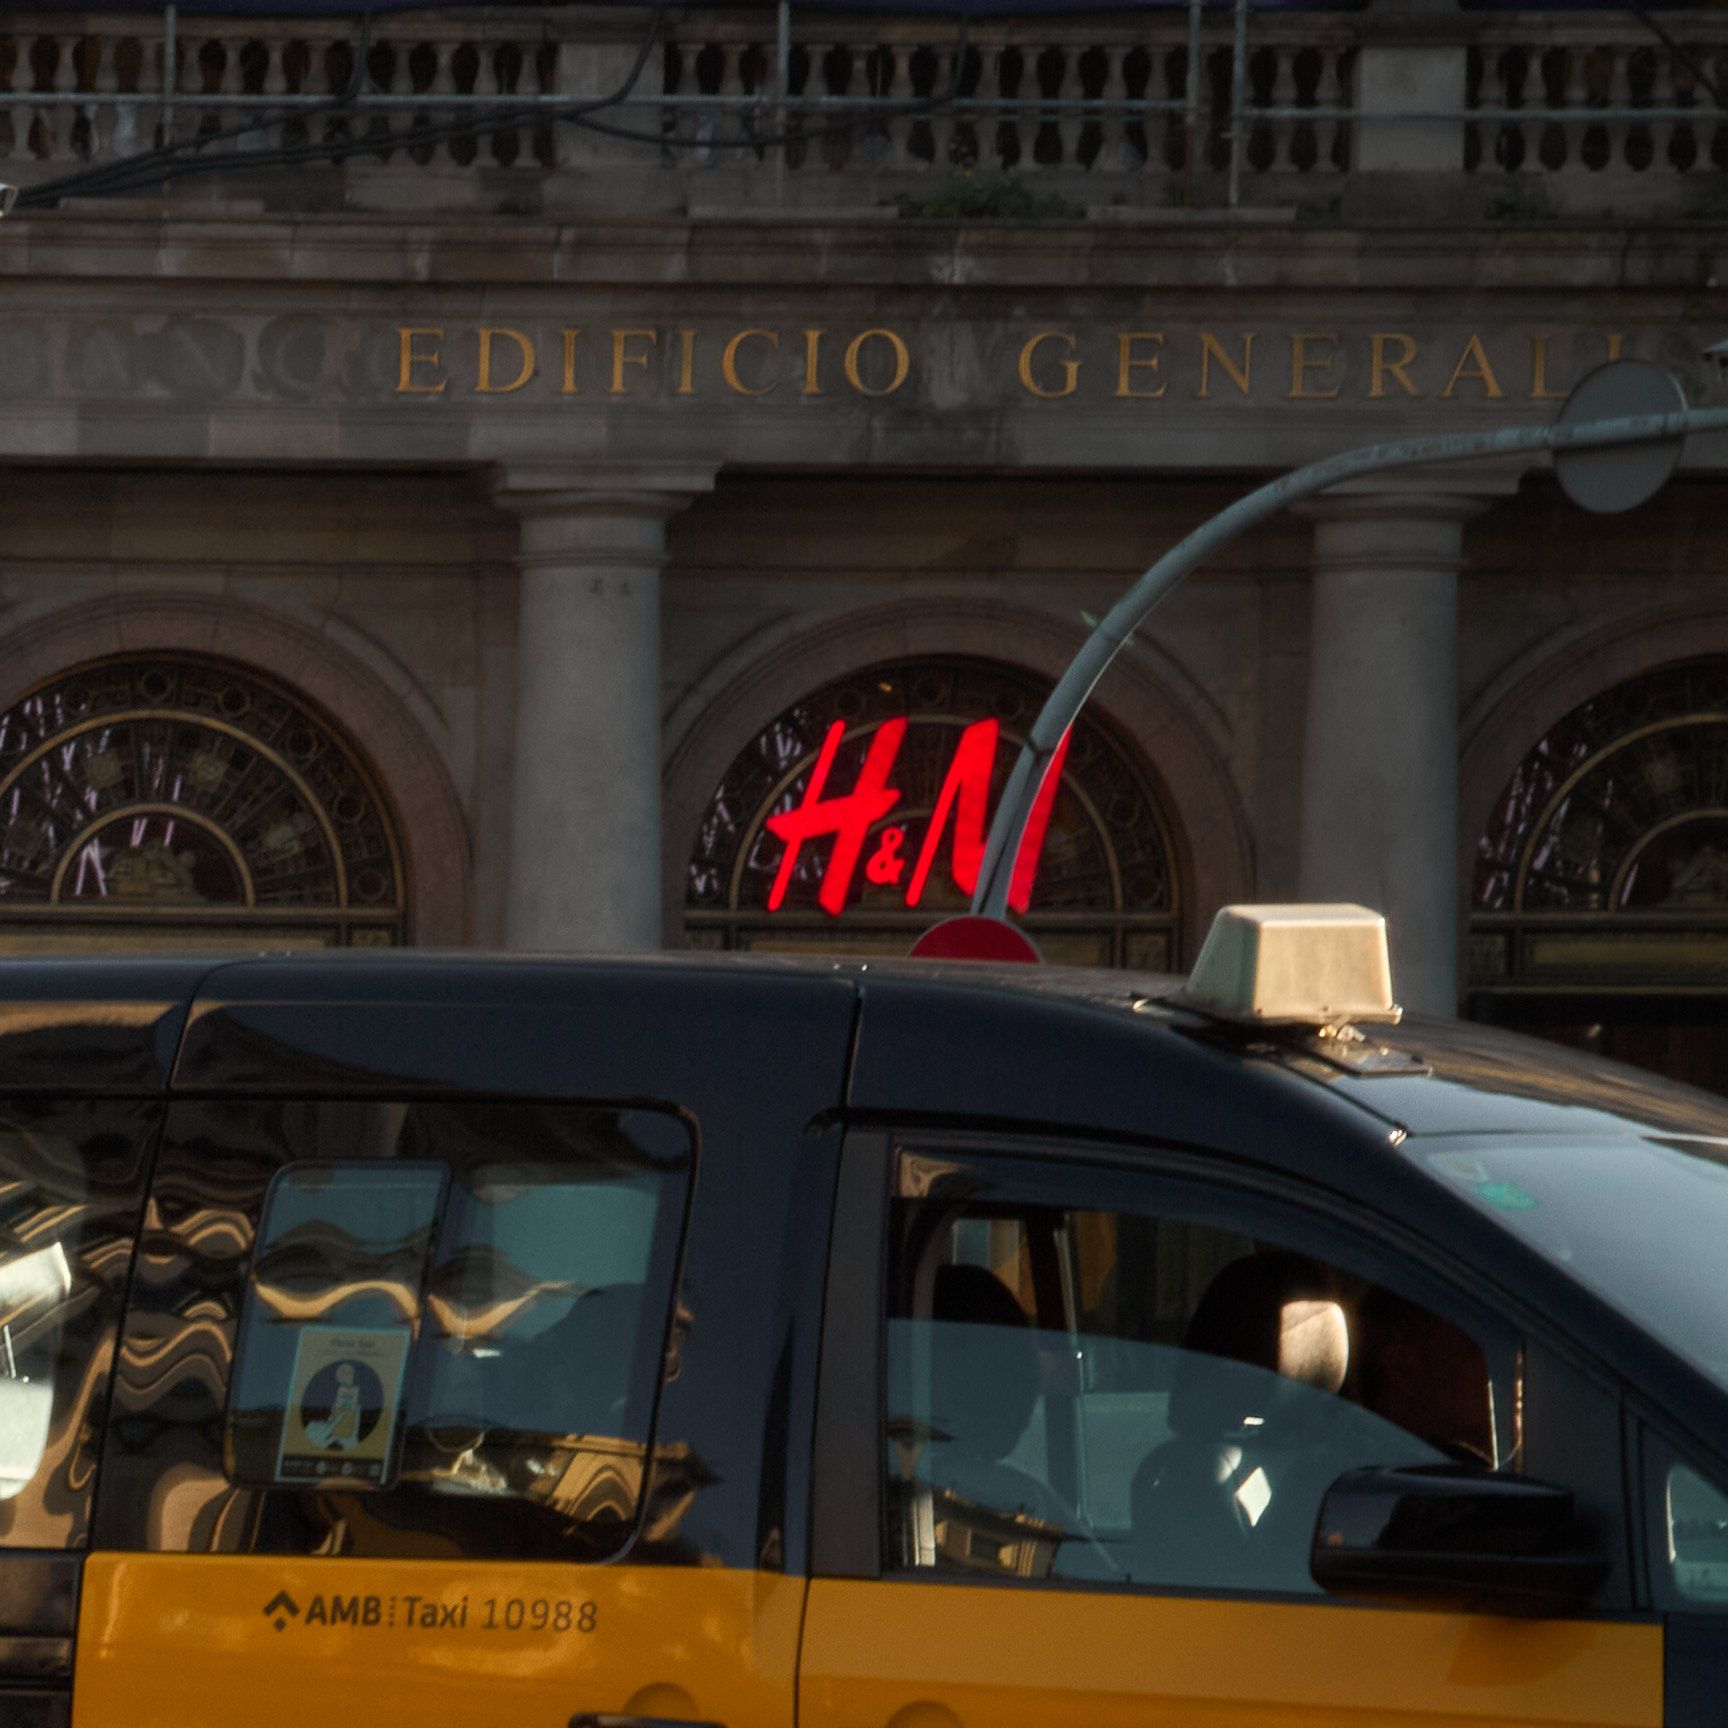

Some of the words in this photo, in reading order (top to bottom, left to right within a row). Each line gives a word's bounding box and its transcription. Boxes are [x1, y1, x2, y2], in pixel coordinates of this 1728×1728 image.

[396, 326, 910, 396] EDIFICIO
[765, 716, 1073, 916] H&M
[304, 1593, 383, 1628] AMB
[403, 1596, 468, 1631] Taxi
[481, 1598, 599, 1634] 10988
